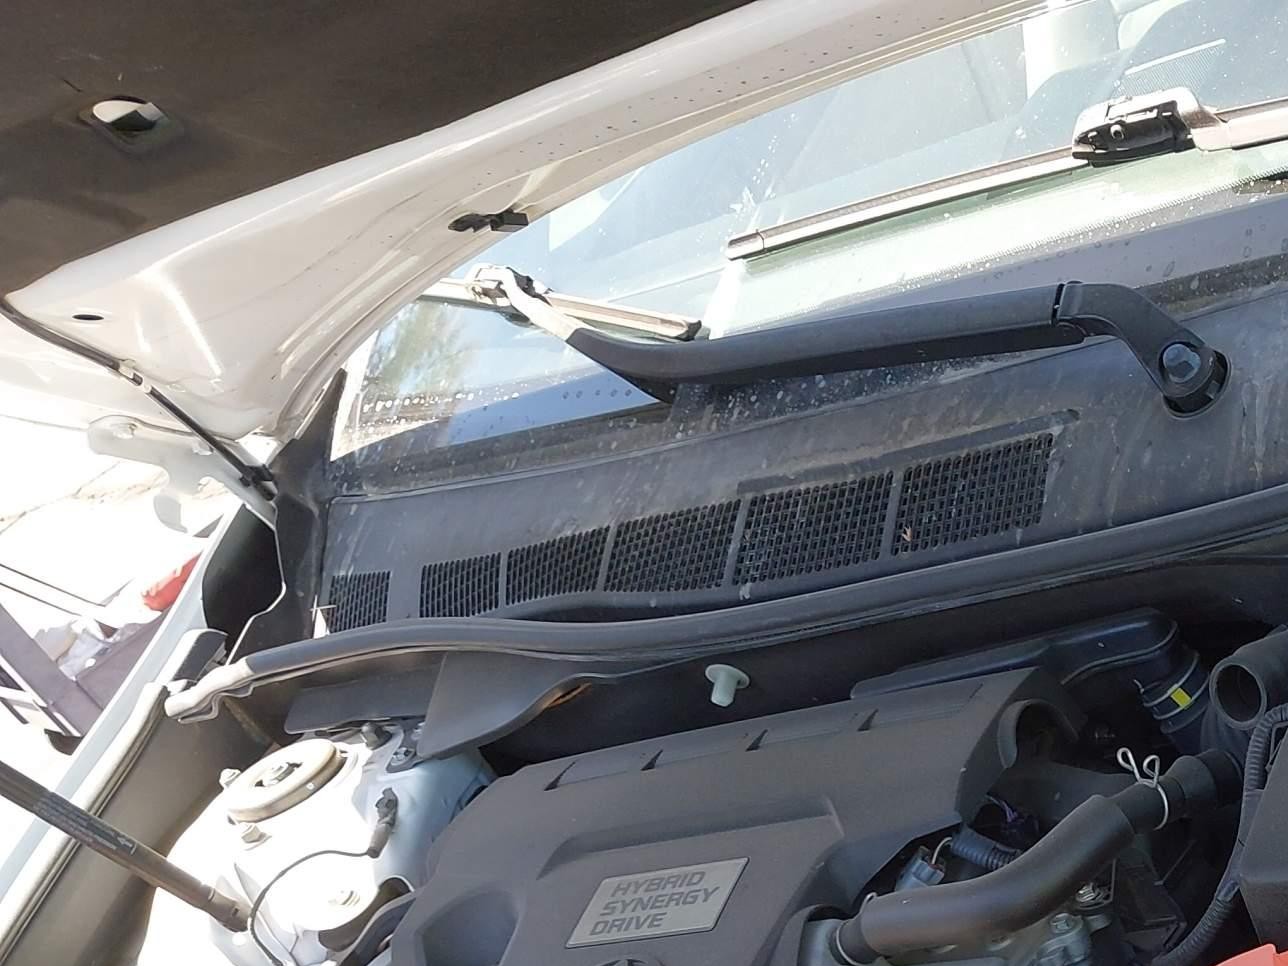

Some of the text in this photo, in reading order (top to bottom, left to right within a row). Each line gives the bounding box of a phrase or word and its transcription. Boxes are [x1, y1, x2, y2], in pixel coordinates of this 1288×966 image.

[610, 872, 706, 897] HYBRID
[600, 886, 720, 916] SYNERGY
[590, 912, 668, 936] DRIVE
